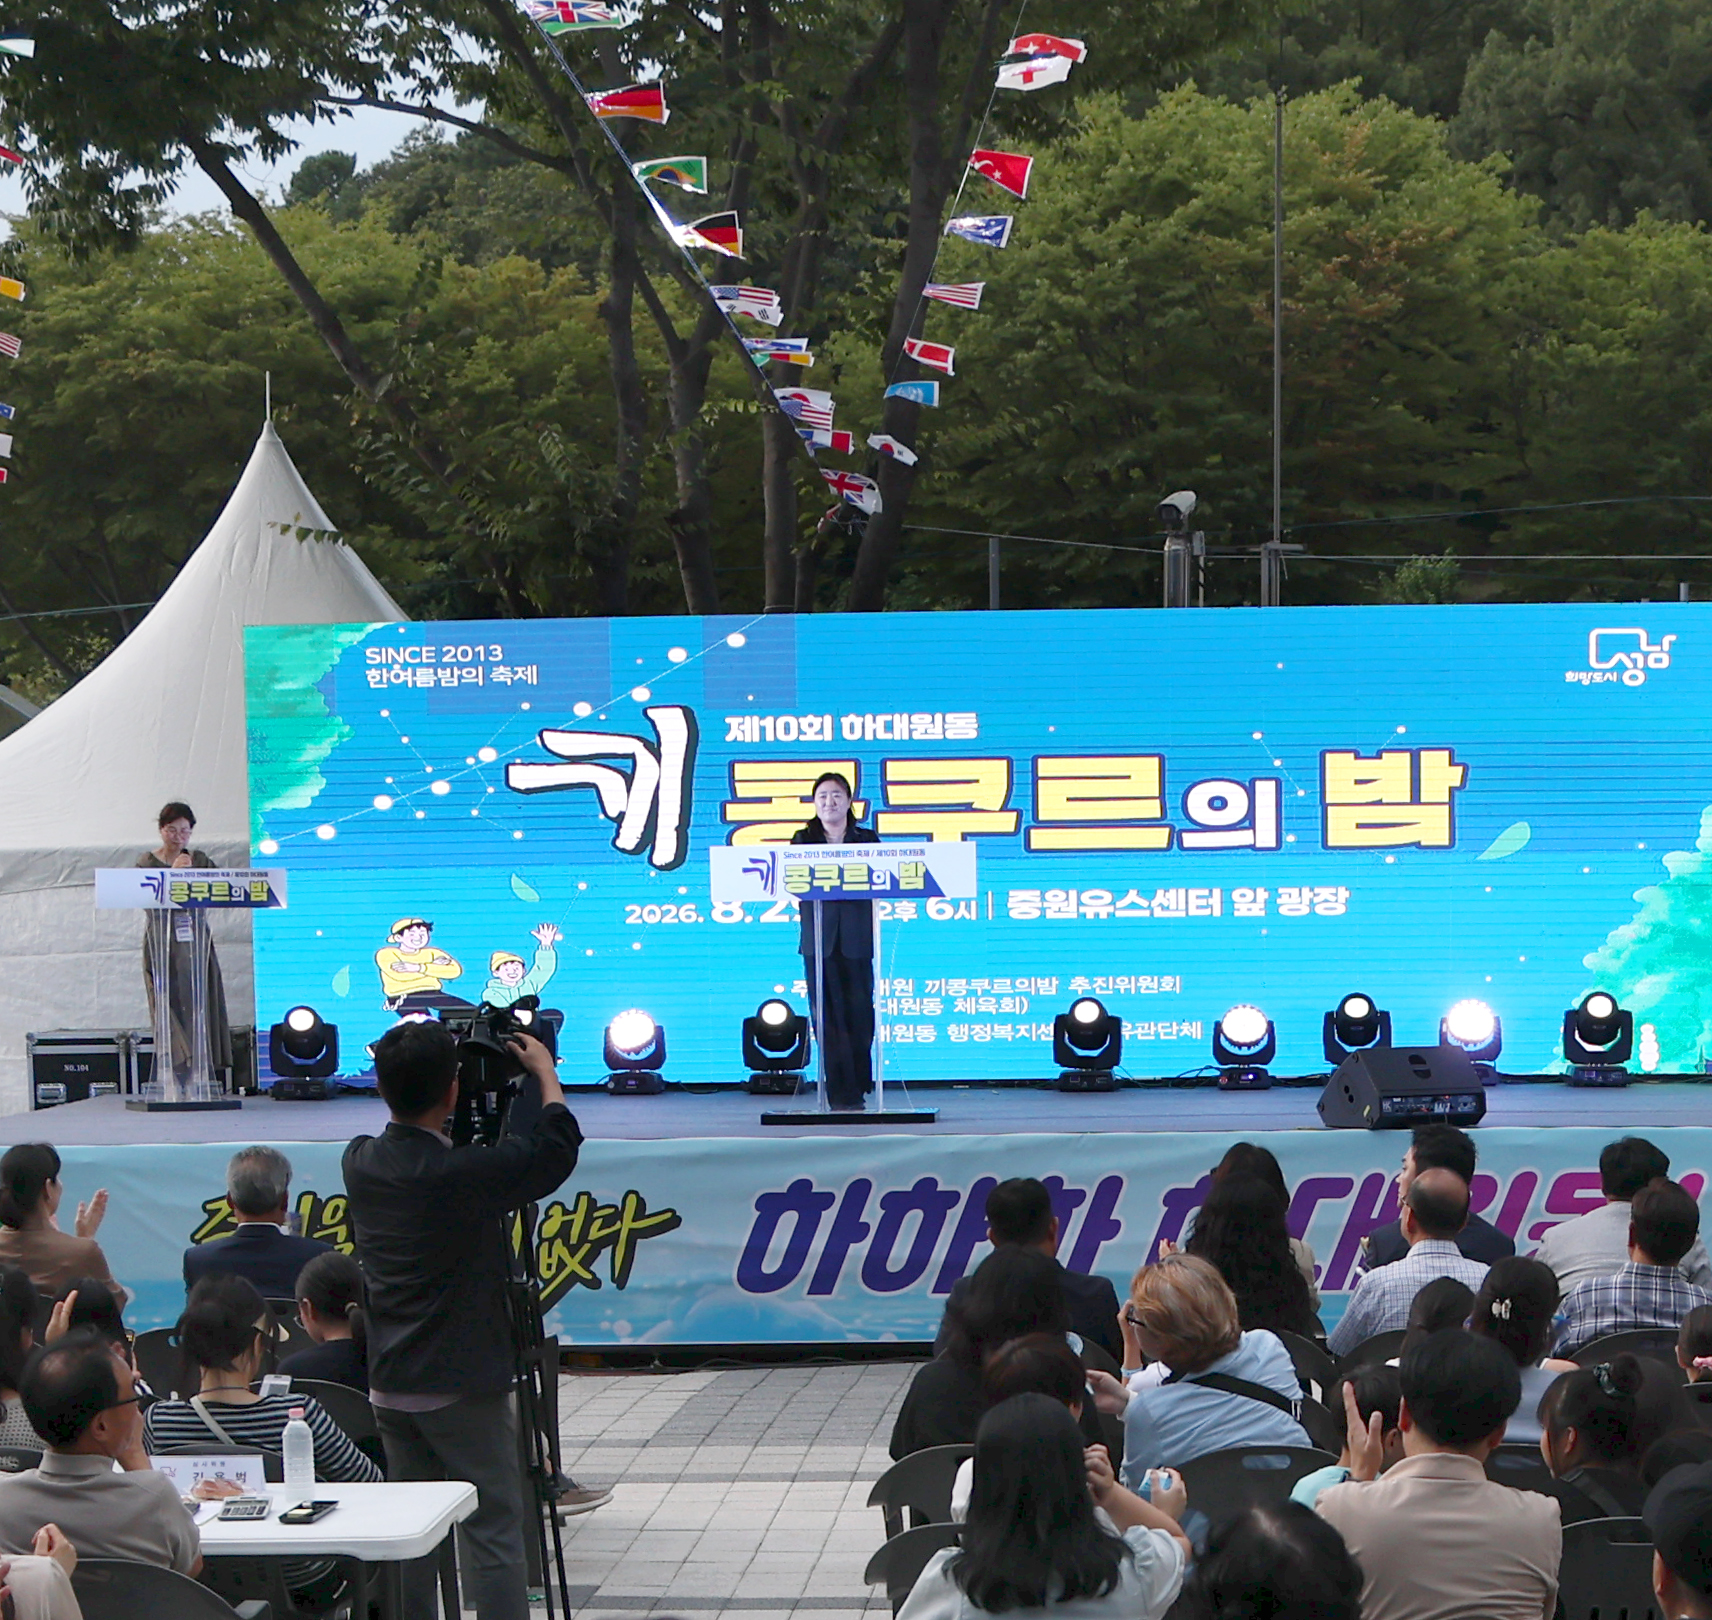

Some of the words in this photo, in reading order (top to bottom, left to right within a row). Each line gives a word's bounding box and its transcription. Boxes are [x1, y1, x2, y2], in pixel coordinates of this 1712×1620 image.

[365, 647, 437, 665] SINCE
[441, 644, 503, 662] 2013
[365, 665, 485, 689] 한여름밤의
[491, 664, 538, 687] 축제
[1564, 671, 1619, 684] 희망도시
[725, 714, 833, 742] 제10회
[840, 712, 979, 741] 하대원동
[1321, 748, 1469, 850] 밤
[784, 851, 802, 859] Since
[803, 850, 820, 858] 2013
[784, 862, 892, 893] 콩쿠르의
[897, 861, 927, 890] 밤
[169, 880, 245, 902] 콩쿠르의
[249, 880, 269, 902] 밤
[624, 904, 705, 925] 2026.
[925, 895, 978, 921] 6시
[1006, 889, 1223, 920] 중원유스센터
[1230, 888, 1269, 920] 앞
[1275, 886, 1350, 917] 광장
[925, 976, 1058, 998] 끼콩쿠르의밤
[1068, 976, 1181, 996] 추진위원회
[953, 996, 1030, 1018] 체육회)
[537, 1190, 678, 1301] 없다
